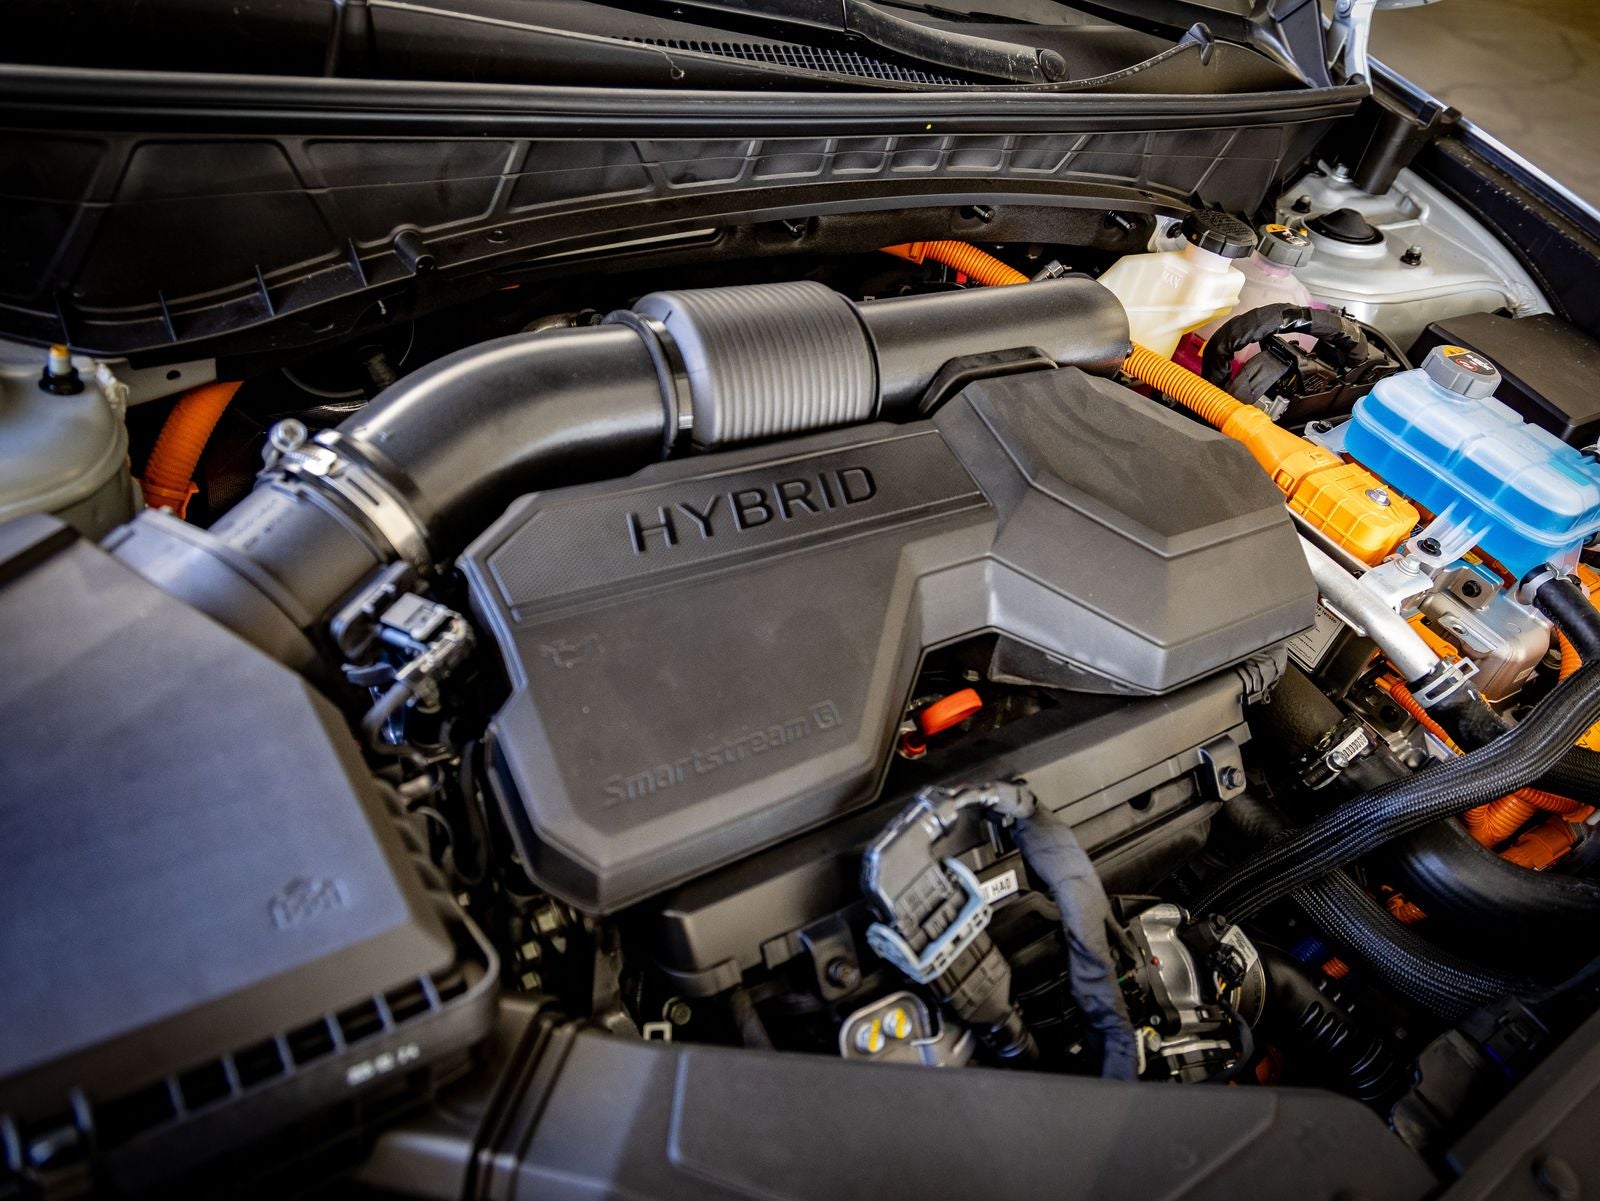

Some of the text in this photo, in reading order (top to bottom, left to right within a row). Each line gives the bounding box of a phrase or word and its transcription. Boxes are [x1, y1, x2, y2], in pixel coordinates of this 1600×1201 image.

[626, 466, 877, 554] HYBRID
[602, 699, 842, 809] Smartstream G
